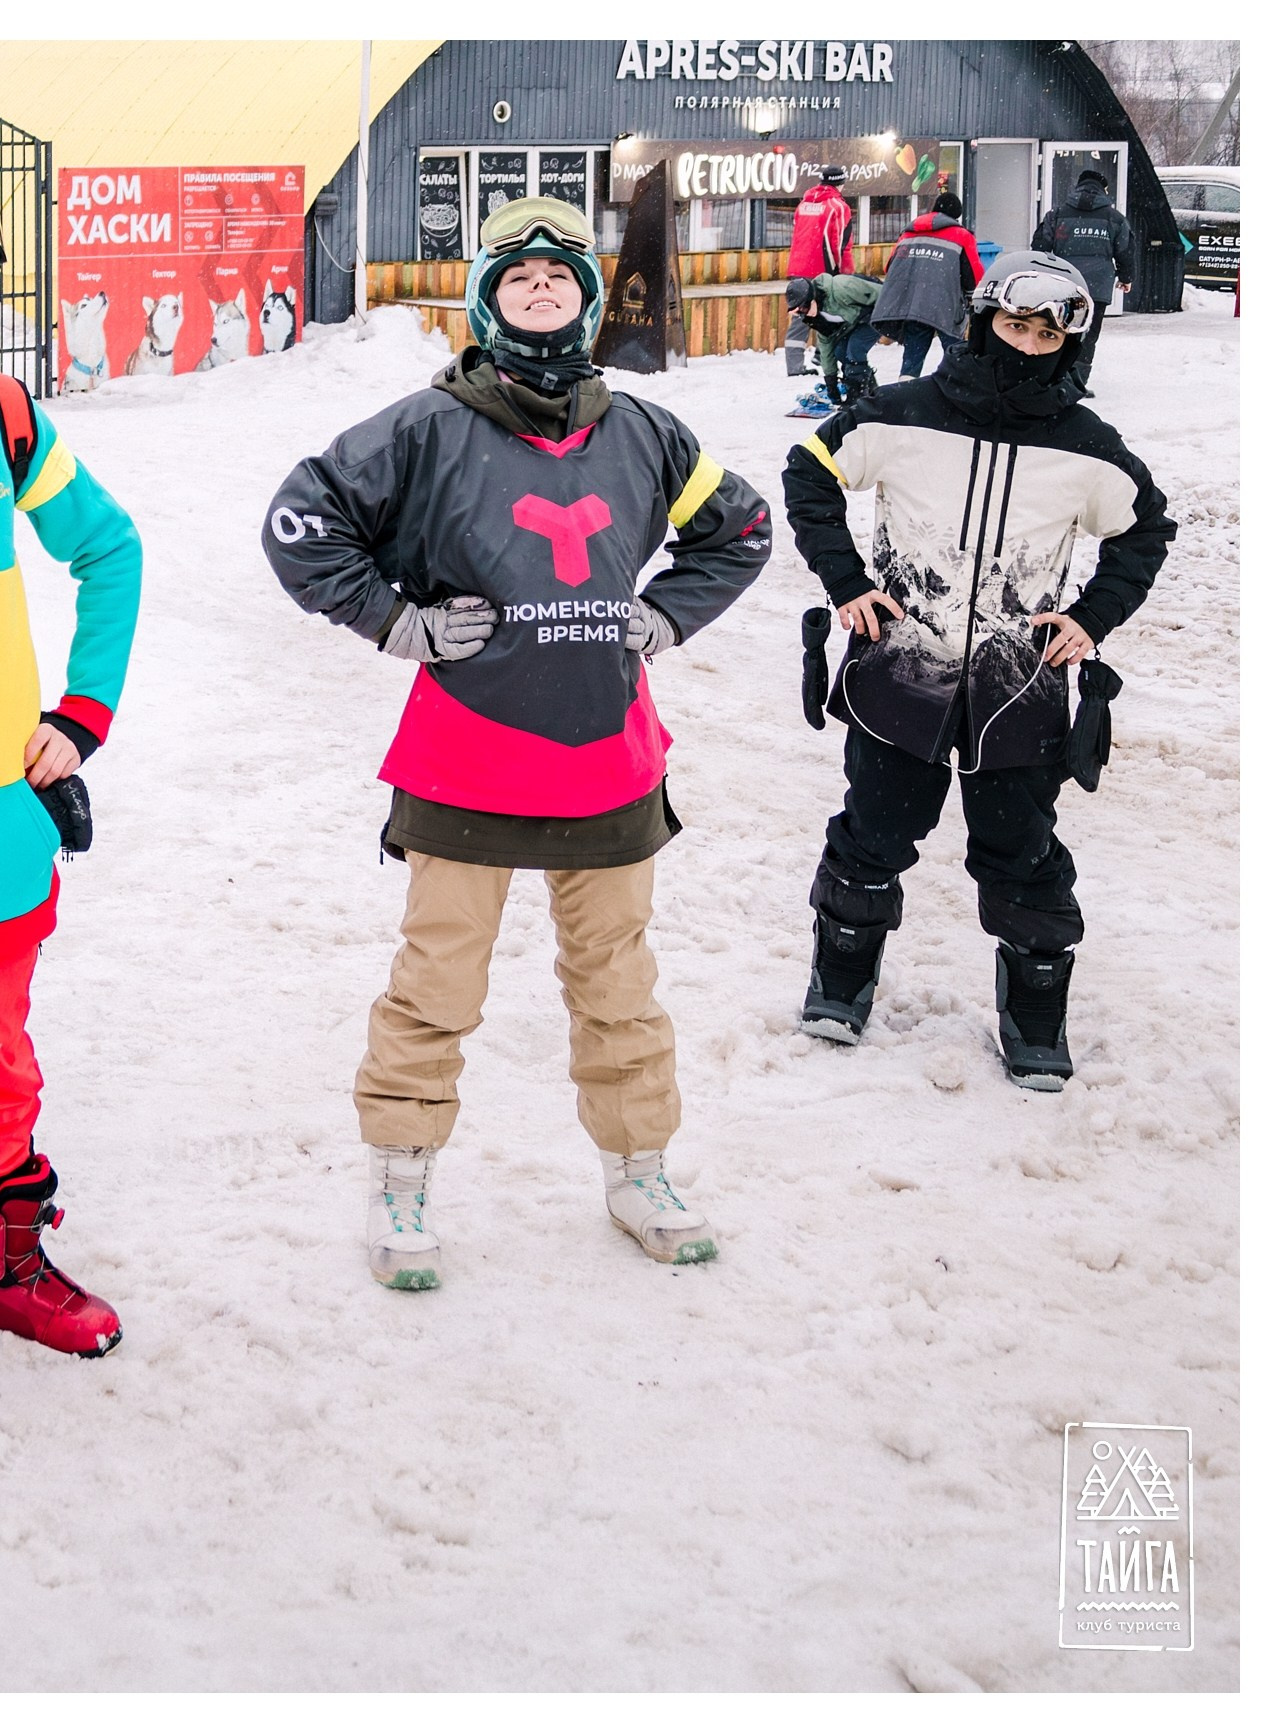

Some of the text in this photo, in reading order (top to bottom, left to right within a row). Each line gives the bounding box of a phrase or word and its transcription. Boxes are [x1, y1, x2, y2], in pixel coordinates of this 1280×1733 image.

[825, 42, 894, 83] BAR
[675, 95, 841, 110] ПОЛЯРНАЯ СТАНЦИЯ
[184, 173, 222, 183] ПРАВИЛА
[420, 173, 458, 185] САЛАТЫ
[480, 173, 526, 184] ТОРТИЛЬЯ
[541, 172, 585, 183] ХОТ-ДОГИ
[677, 152, 799, 198] PETRUCCIO
[849, 162, 889, 181] PASTA
[67, 175, 142, 211] ДОМ
[67, 213, 171, 245] ХАСКИ
[503, 599, 632, 622] ТЮМЕНСКО
[537, 624, 619, 643] ВРЕМЯ
